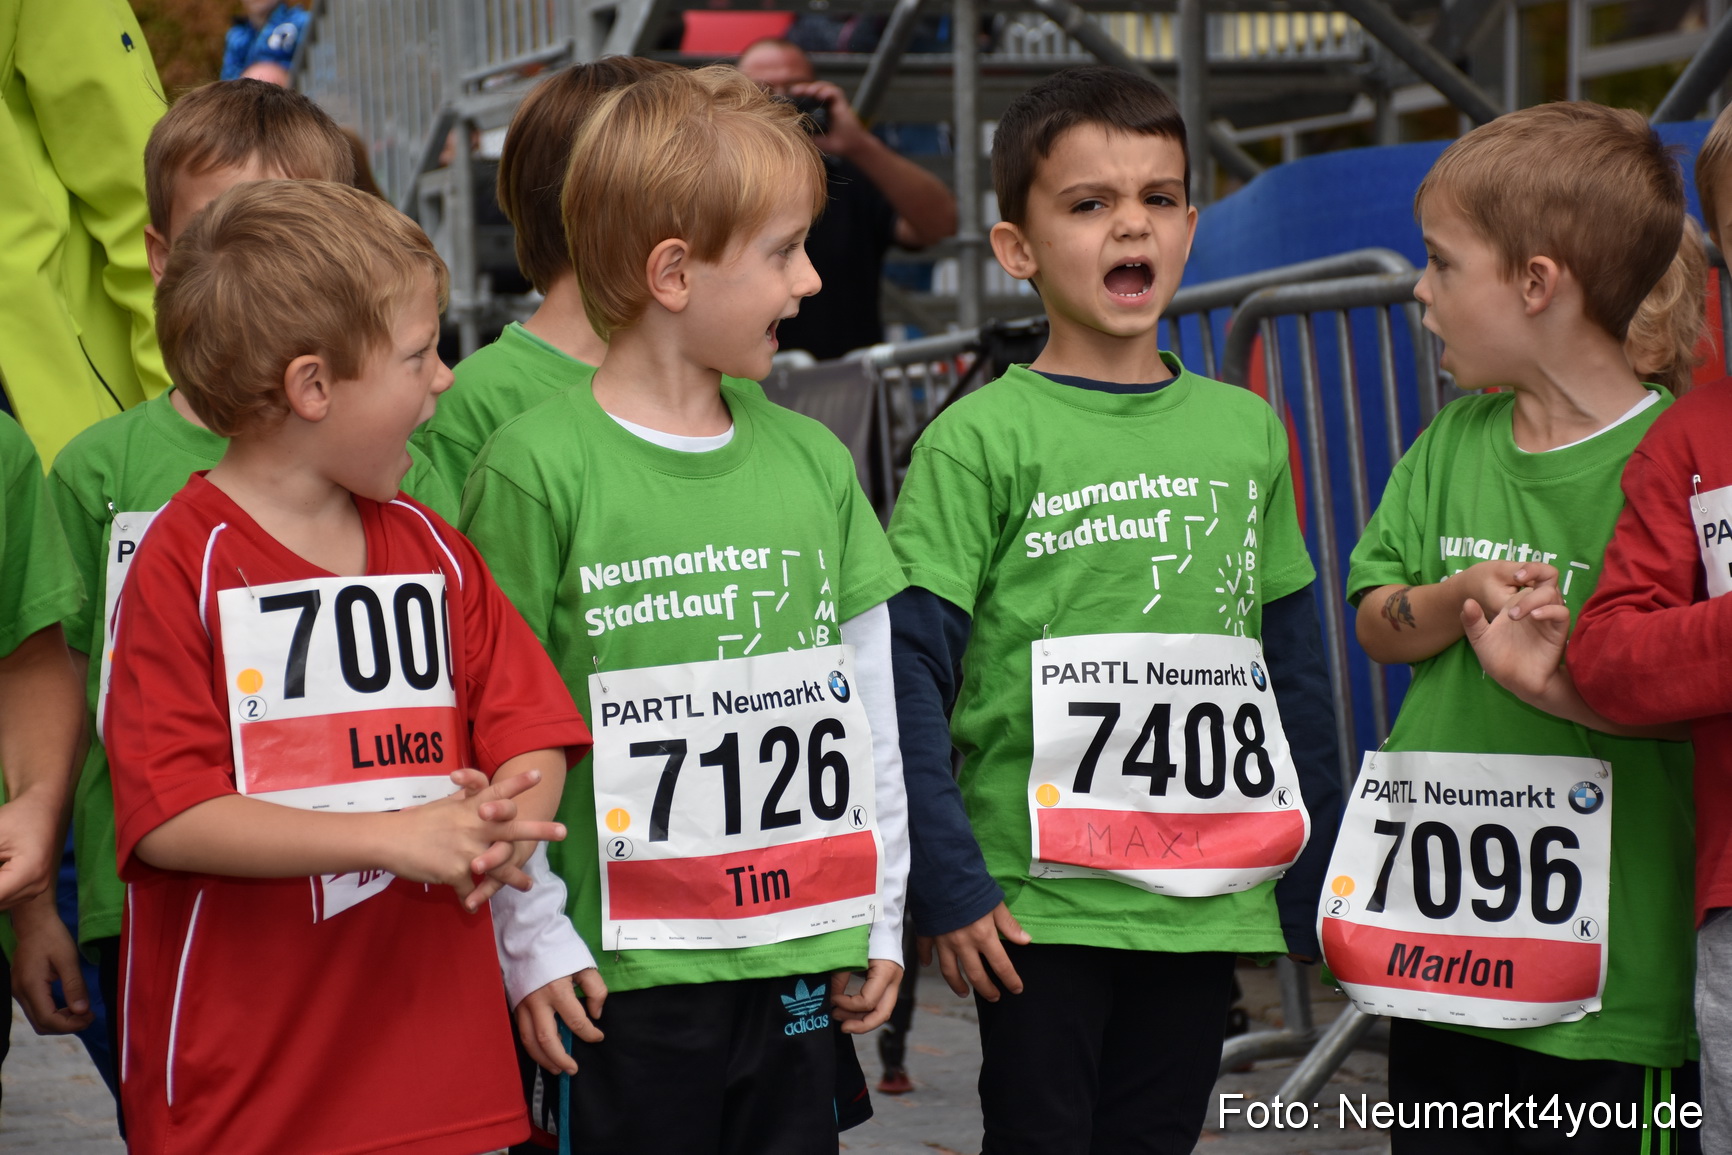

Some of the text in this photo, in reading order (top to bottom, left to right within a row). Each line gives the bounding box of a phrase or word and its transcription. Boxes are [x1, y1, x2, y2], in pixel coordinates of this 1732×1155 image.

[1026, 473, 1199, 519] Neumarkter
[1024, 508, 1172, 559] Stadtlauf
[579, 544, 771, 594] Neumarkter
[585, 584, 739, 637] Stadtlauf
[1041, 660, 1138, 686] PARTL
[1146, 660, 1248, 687] Neumarkt
[247, 699, 258, 718] 2
[601, 680, 826, 728] PARTL Neumarkt
[349, 723, 444, 770] Lukas
[1067, 701, 1276, 800] 7408
[629, 717, 851, 843] 7126
[1278, 790, 1288, 806] K
[1361, 778, 1556, 810] PARTL Neumarkt
[853, 809, 862, 826] K
[615, 840, 625, 857] 2
[1087, 822, 1205, 860] MAXI
[726, 864, 791, 908] Tim
[1365, 819, 1583, 926] 7096
[1331, 899, 1343, 915] 2
[1580, 920, 1593, 938] K
[1387, 942, 1515, 988] Marlon
[784, 1014, 829, 1036] adidas
